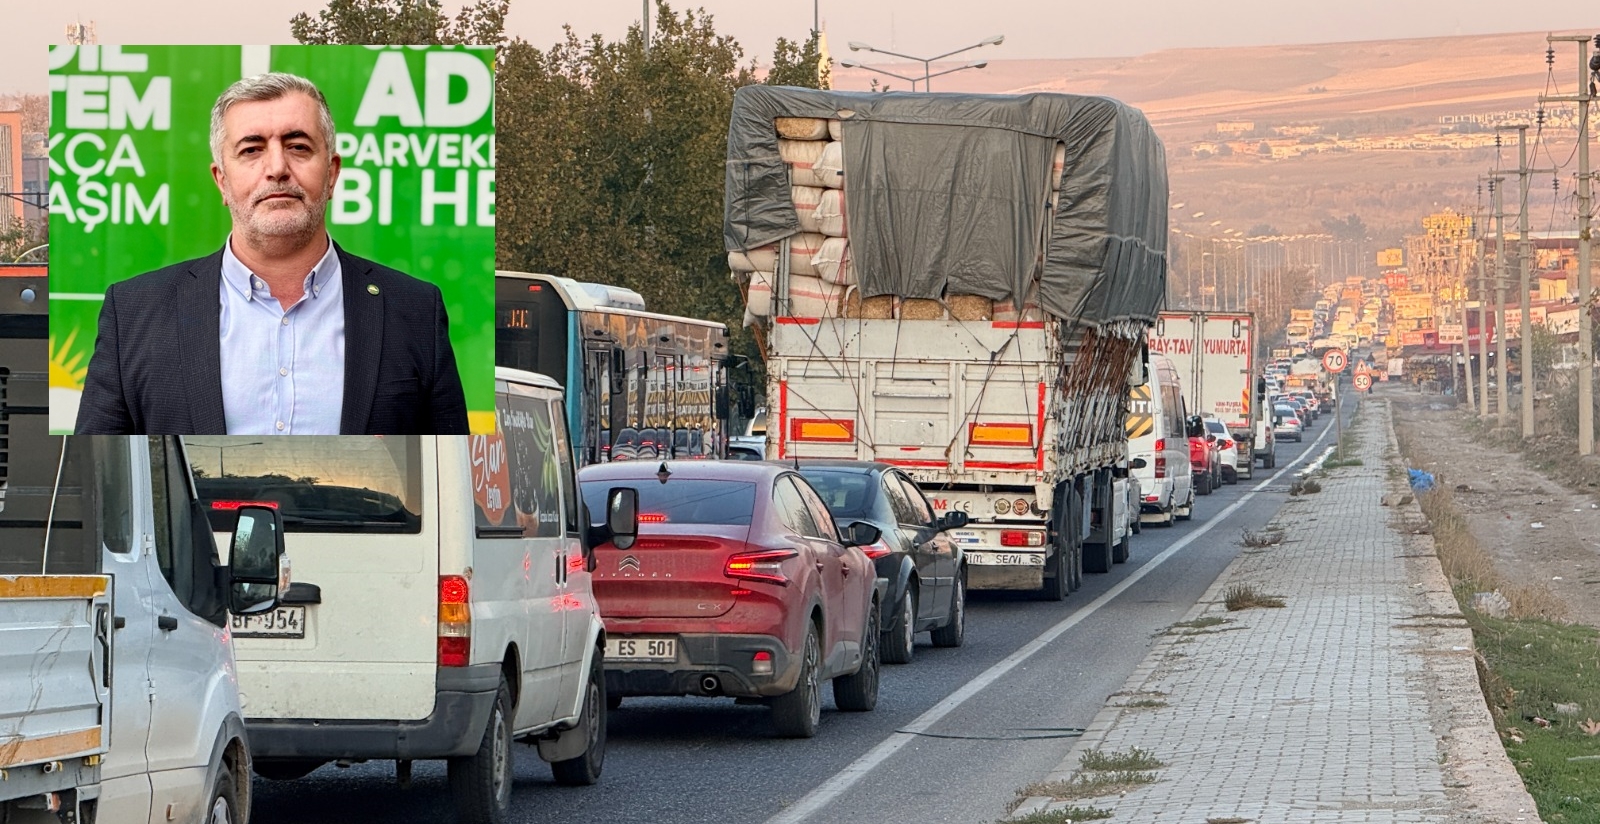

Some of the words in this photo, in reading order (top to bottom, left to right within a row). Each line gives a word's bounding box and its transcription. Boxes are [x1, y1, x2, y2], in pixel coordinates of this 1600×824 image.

[353, 51, 495, 128] AD
[331, 167, 393, 225] BI
[49, 180, 170, 233] AŞIM
[1203, 338, 1247, 355] YUMURTA
[1328, 355, 1342, 366] 70
[1356, 377, 1368, 386] 50
[1128, 400, 1151, 413] ITI
[264, 609, 298, 630] 954
[618, 640, 636, 656] ES
[648, 640, 673, 656] 501
